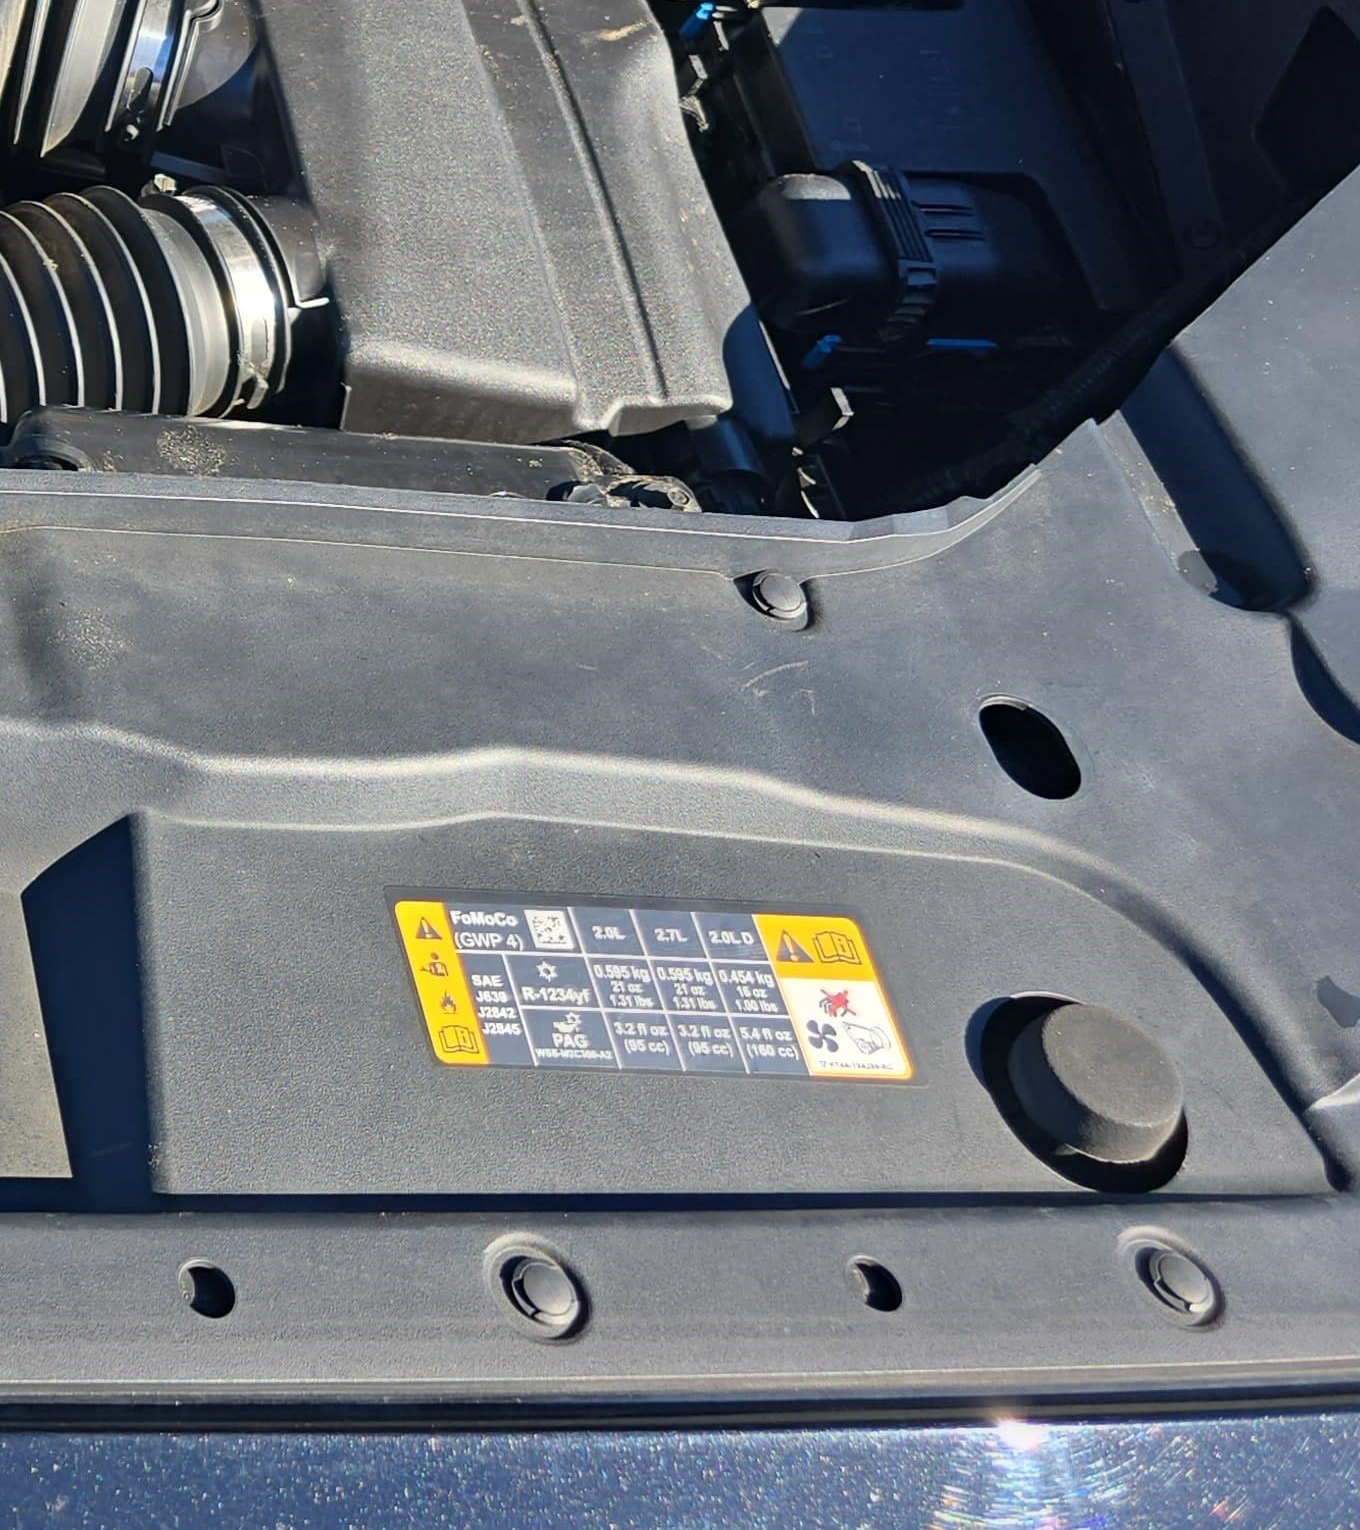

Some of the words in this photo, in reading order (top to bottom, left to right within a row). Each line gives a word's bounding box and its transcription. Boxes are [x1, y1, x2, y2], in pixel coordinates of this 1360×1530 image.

[450, 911, 518, 927] FoMoCo
[592, 926, 626, 940] 2.0L
[655, 928, 688, 942] 2.7L
[708, 931, 739, 944] 2.0L
[740, 932, 754, 944] D
[455, 933, 503, 949] (GWP
[506, 934, 523, 951] 4)
[593, 964, 630, 979] 0.595
[632, 966, 651, 982] kg
[656, 967, 693, 981] 0.595
[694, 968, 713, 986] kg
[718, 970, 754, 984] 0.454
[756, 971, 774, 988] kg
[472, 975, 503, 986] SAE
[611, 981, 624, 992] 21
[628, 982, 644, 993] oz
[476, 991, 508, 1002] J639
[522, 986, 590, 1005] R-1234yf
[674, 983, 688, 995] 21
[690, 986, 706, 996] oz
[753, 989, 768, 998] oz
[609, 994, 632, 1006] 1.31
[634, 995, 654, 1007] lbs
[672, 997, 696, 1009] 1.31
[697, 998, 718, 1009] lbs
[736, 999, 758, 1011] 1.00
[760, 1000, 778, 1012] lbs
[478, 1007, 517, 1018] J2842
[614, 1022, 635, 1035] 3.2
[637, 1022, 647, 1036] fl
[650, 1026, 669, 1036] oz
[678, 1024, 699, 1038] 3.2
[701, 1025, 711, 1038] fl
[714, 1028, 732, 1038] oz
[740, 1027, 761, 1039] 5.4
[762, 1028, 772, 1040] fl
[775, 1031, 792, 1041] oz
[552, 1033, 589, 1048] PAG
[624, 1039, 646, 1054] (95
[648, 1040, 669, 1056] cc)
[688, 1041, 709, 1056] (95
[712, 1042, 734, 1058] cc)
[777, 1046, 799, 1060] cc)
